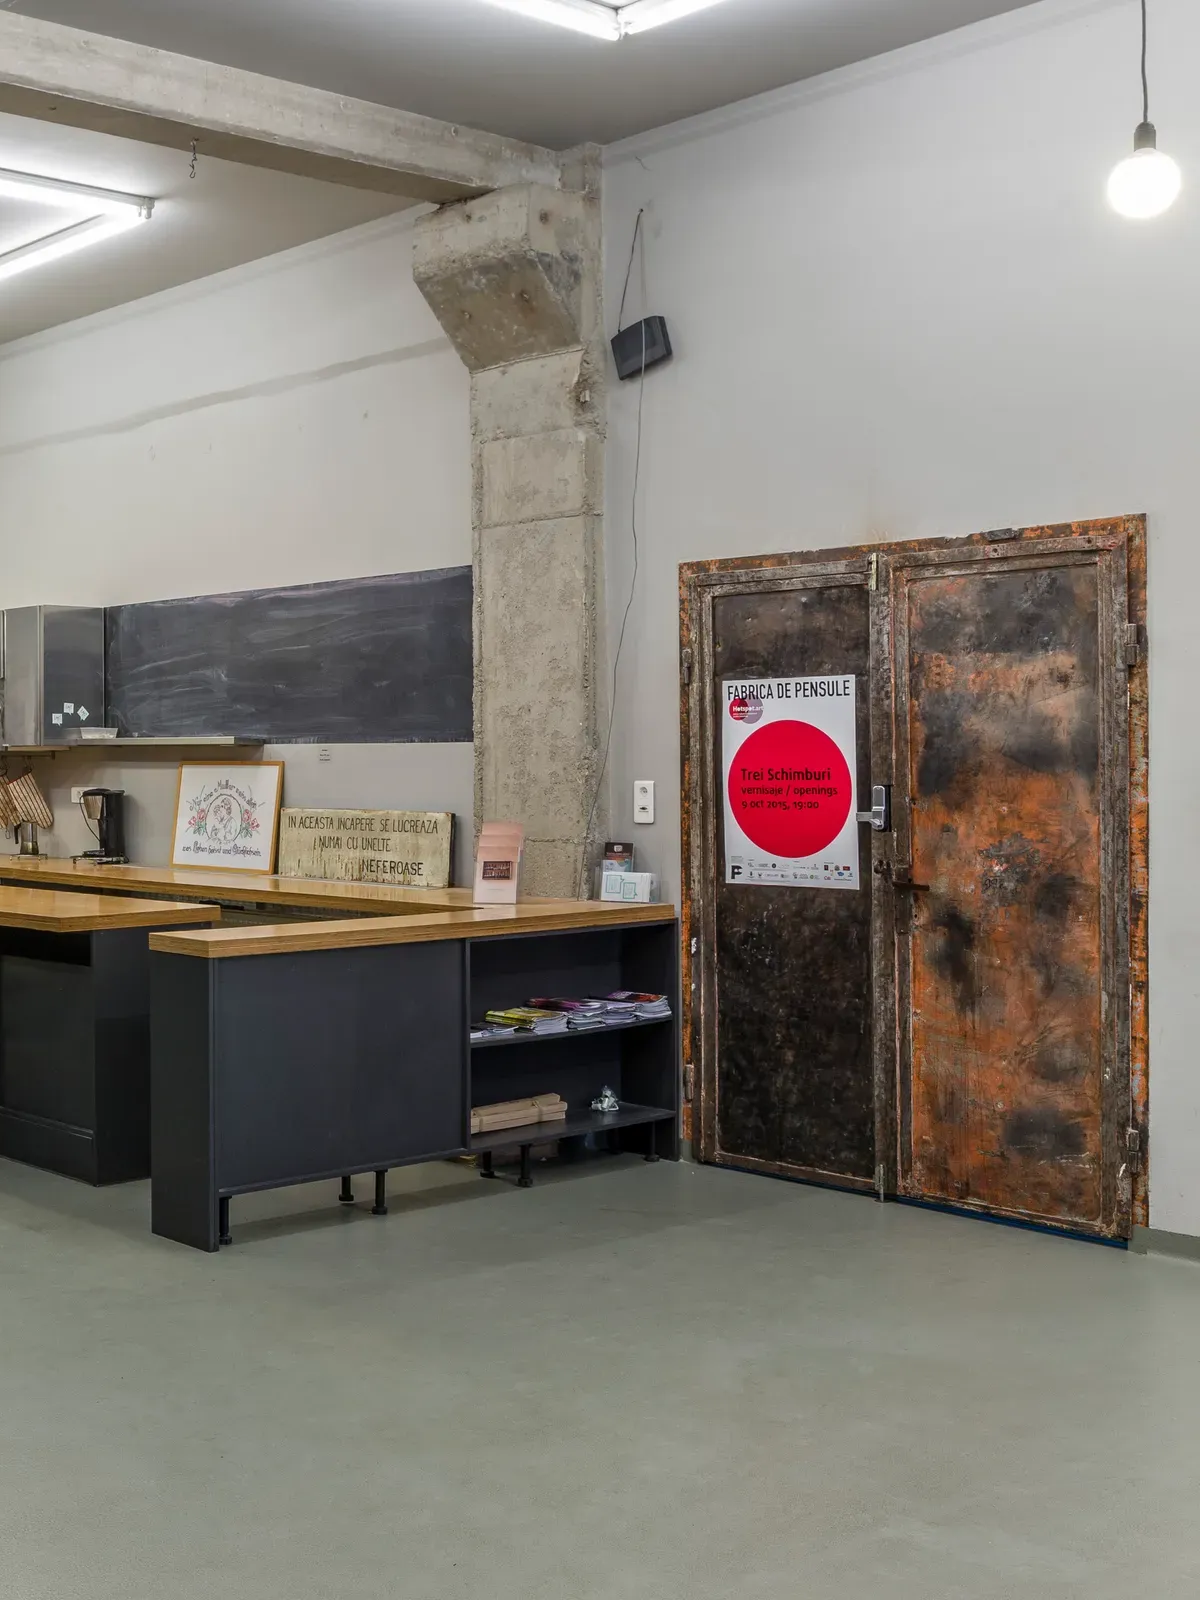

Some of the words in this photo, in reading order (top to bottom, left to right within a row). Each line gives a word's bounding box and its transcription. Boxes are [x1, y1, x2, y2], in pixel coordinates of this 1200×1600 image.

[728, 684, 774, 700] FABRICA
[777, 682, 791, 699] DE
[795, 680, 850, 698] PENSULE
[741, 768, 764, 780] Trei
[768, 768, 830, 780] Schimburi
[741, 786, 783, 796] vernisaje
[794, 786, 838, 797] openings
[767, 801, 790, 810] 2015,
[794, 801, 819, 810] 19:00
[288, 816, 296, 828] IN
[299, 816, 334, 830] ACEASTA
[338, 817, 375, 831] INCAPERE
[380, 819, 390, 832] SE
[319, 836, 342, 849] NUMAI
[347, 837, 358, 850] CU
[362, 838, 391, 852] UNELTE
[362, 859, 424, 876] NEFEROASE
